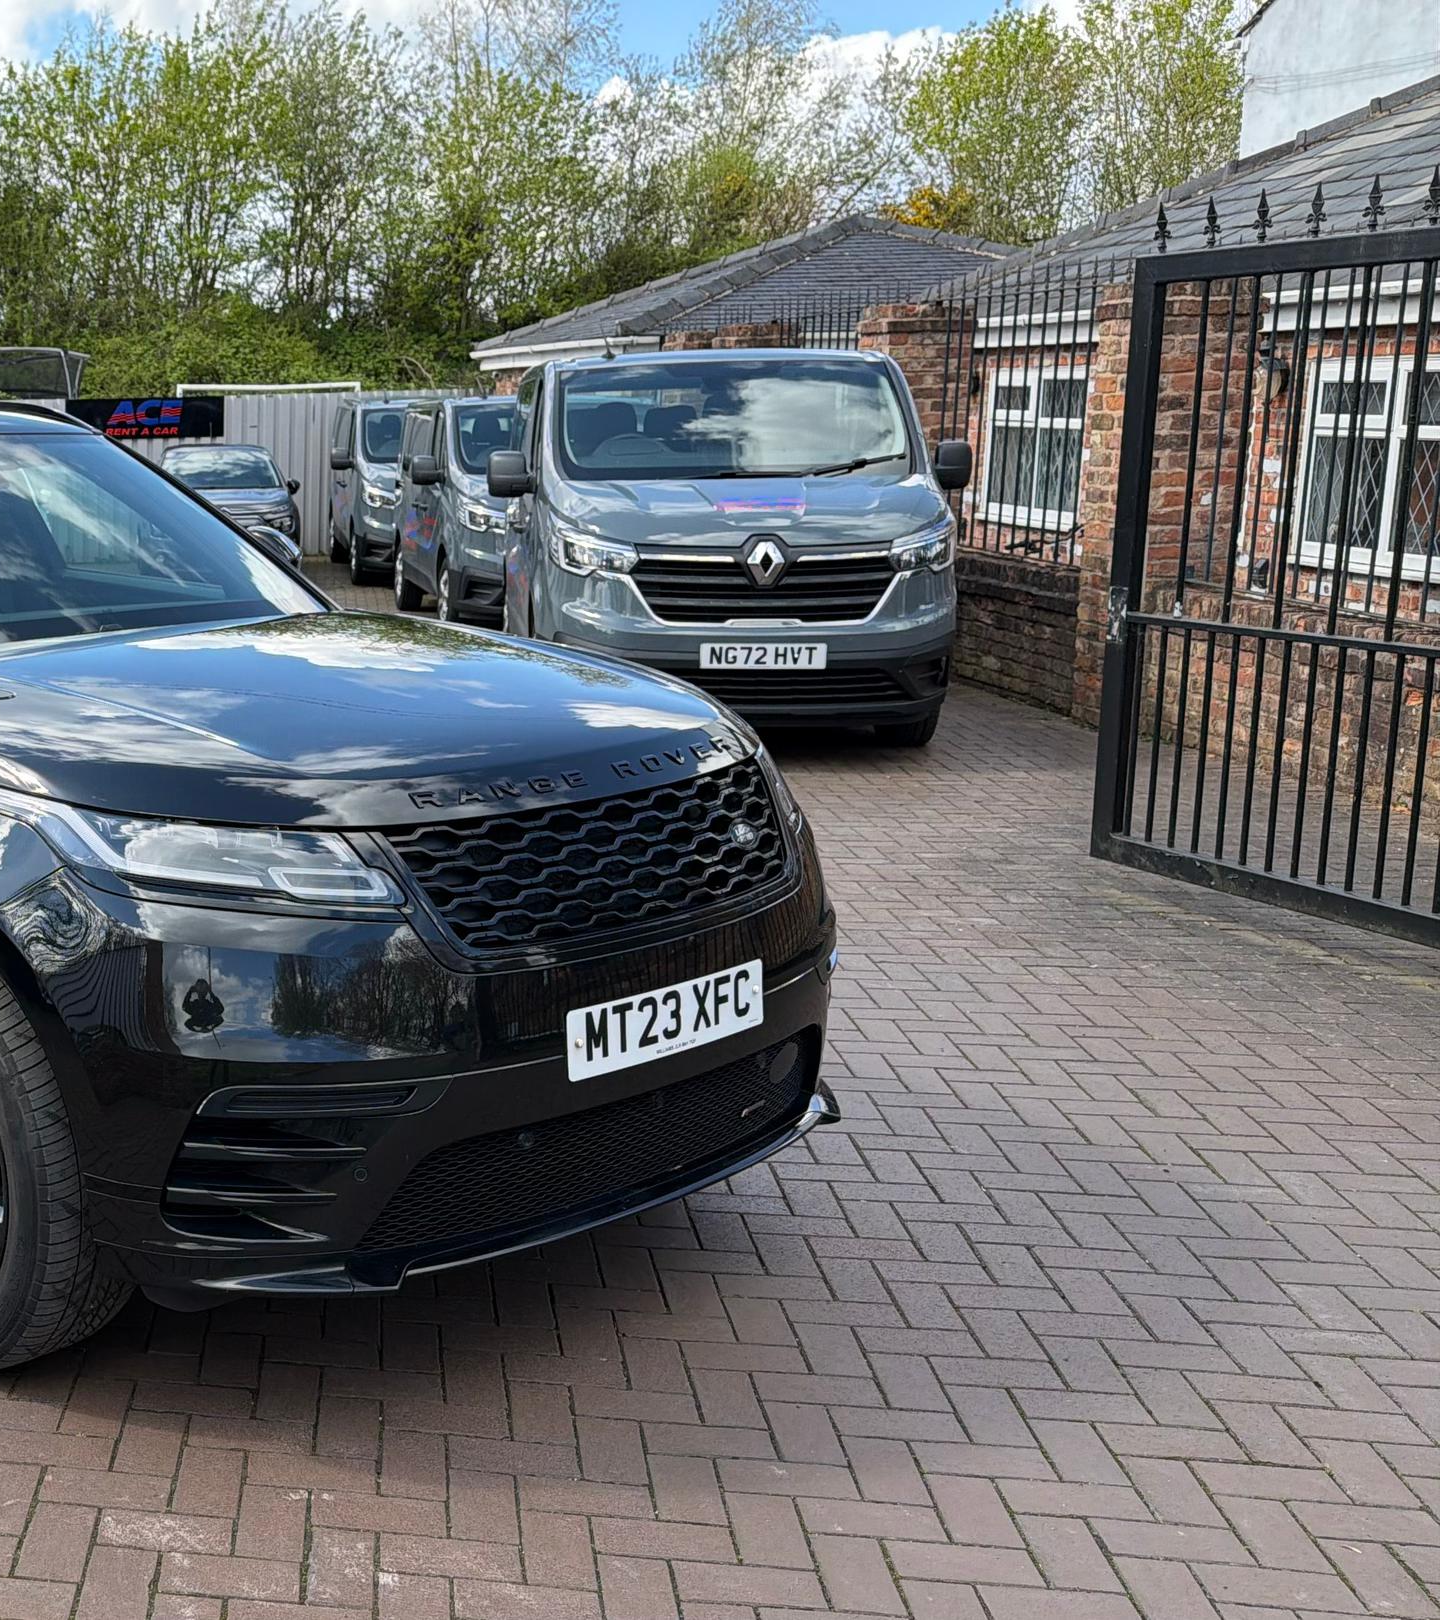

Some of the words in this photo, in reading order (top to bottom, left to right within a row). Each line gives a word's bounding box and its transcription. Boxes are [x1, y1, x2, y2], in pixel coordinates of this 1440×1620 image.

[106, 399, 183, 425] ACE
[106, 427, 139, 436] RENT
[140, 427, 150, 436] A
[152, 426, 179, 436] CAR
[709, 646, 768, 665] NG72
[773, 646, 818, 665] HVT
[407, 769, 590, 810] RANGE
[610, 735, 734, 780] ROVER
[585, 989, 682, 1062] MT23
[692, 969, 751, 1033] XFC
